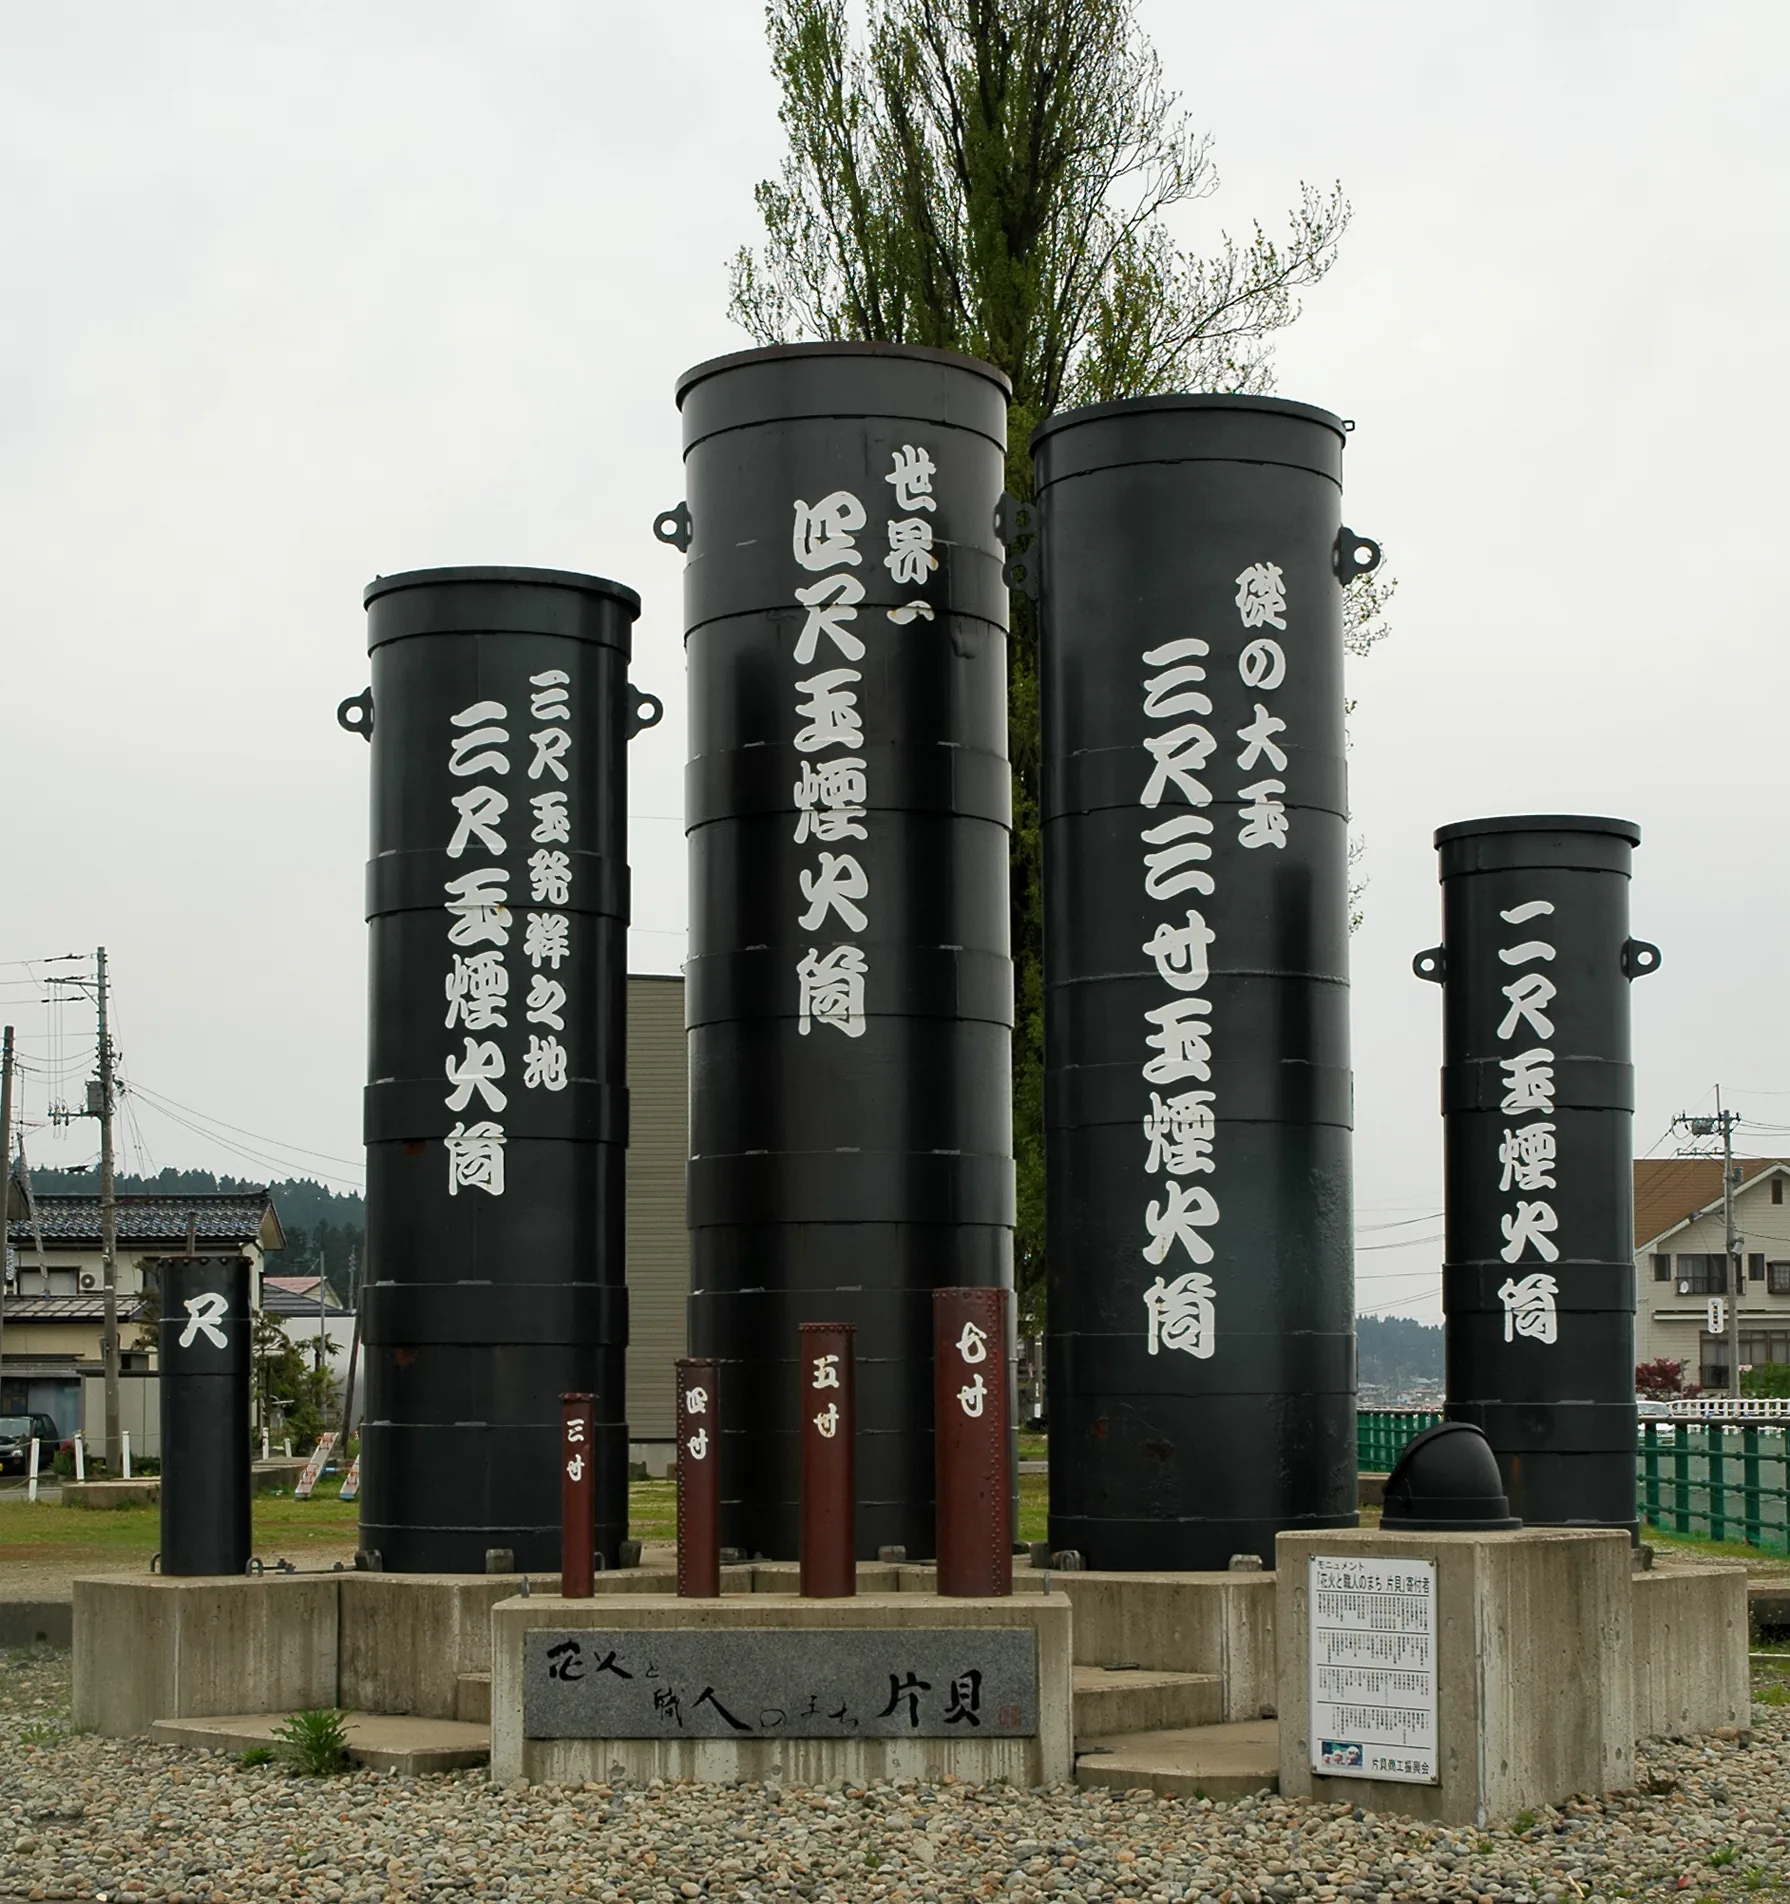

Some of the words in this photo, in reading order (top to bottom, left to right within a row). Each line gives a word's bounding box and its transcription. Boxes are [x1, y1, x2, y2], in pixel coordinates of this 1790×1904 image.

[793, 490, 868, 1038] 四尺玉煙火筒
[884, 445, 938, 625] 世界一
[444, 700, 513, 1196] 三尺玉煙火筒
[1140, 637, 1219, 1360] 三尺三寸玉煙火筒
[1497, 900, 1559, 1345] 二尺玉煙火筒
